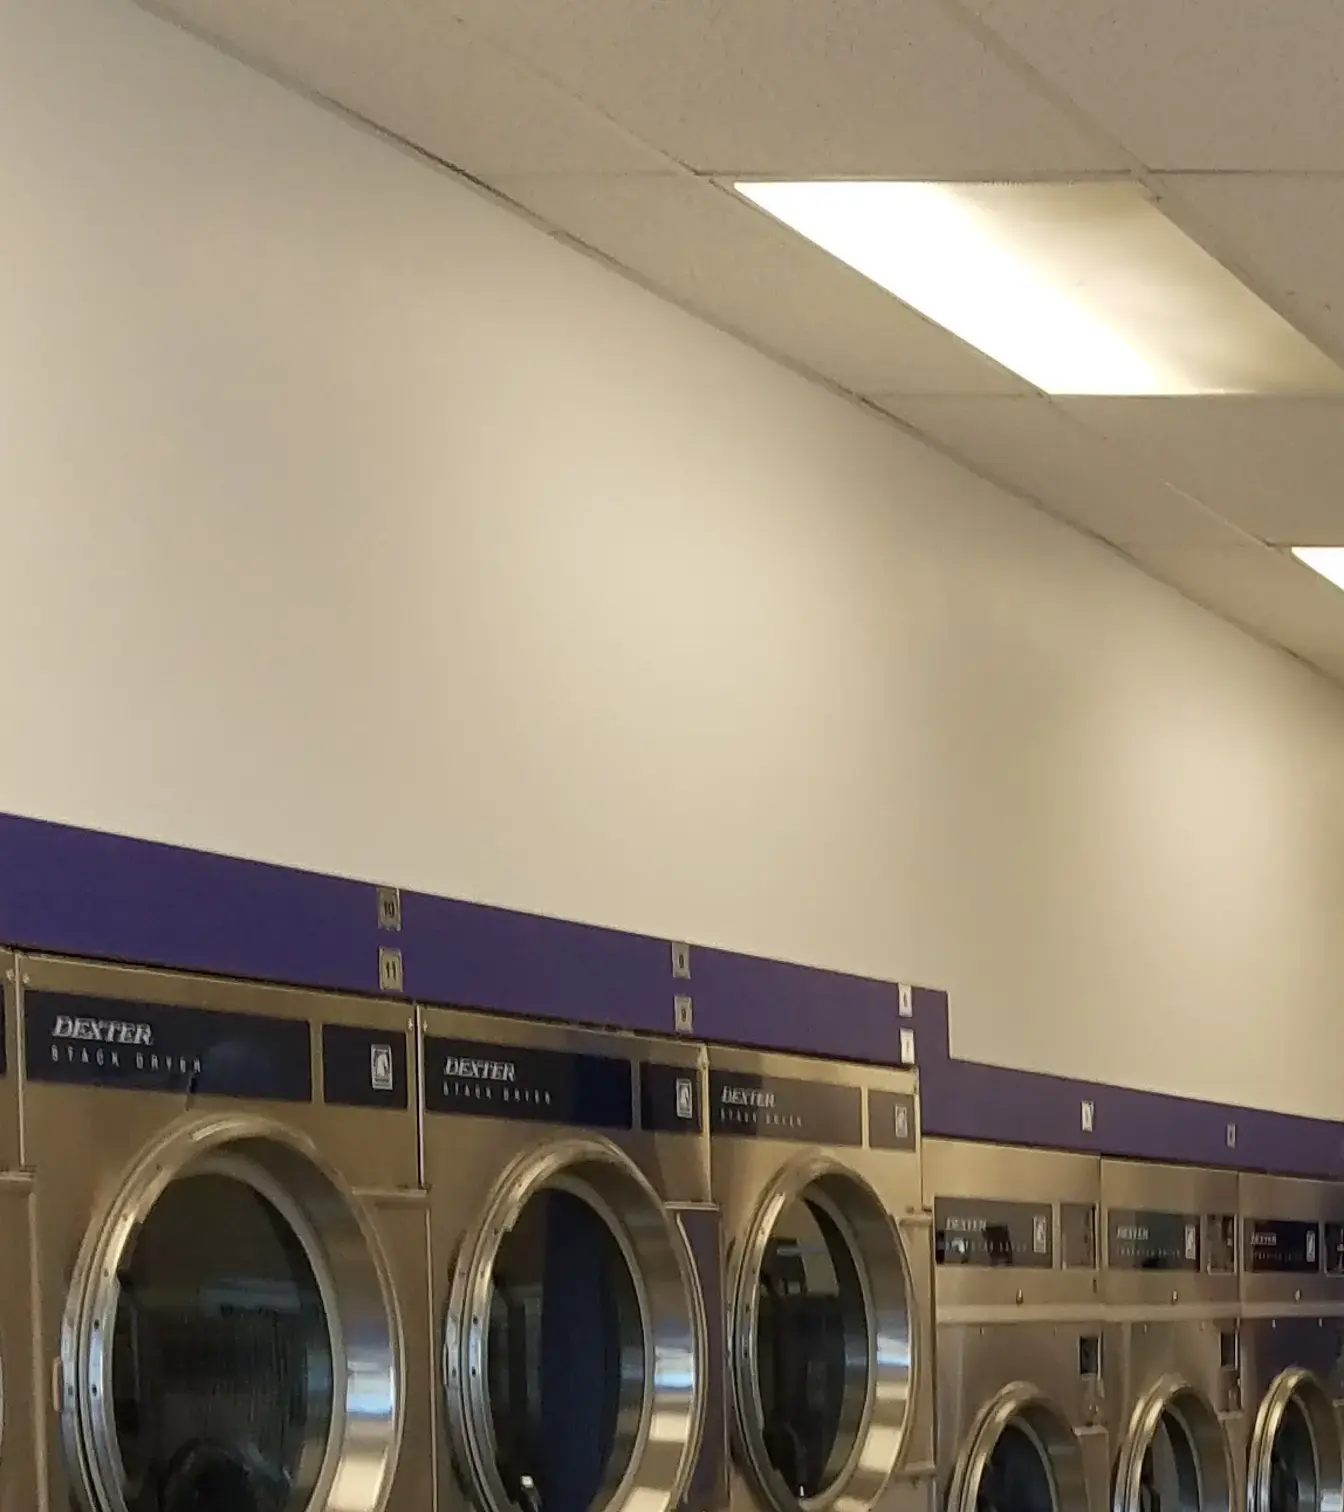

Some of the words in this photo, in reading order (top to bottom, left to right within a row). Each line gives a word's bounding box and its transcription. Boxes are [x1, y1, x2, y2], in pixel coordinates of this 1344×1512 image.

[383, 901, 396, 919] 10
[385, 960, 397, 980] 11
[52, 1014, 154, 1046] DEXTER
[444, 1056, 516, 1083] DEXTER
[721, 1085, 776, 1109] DEXTER
